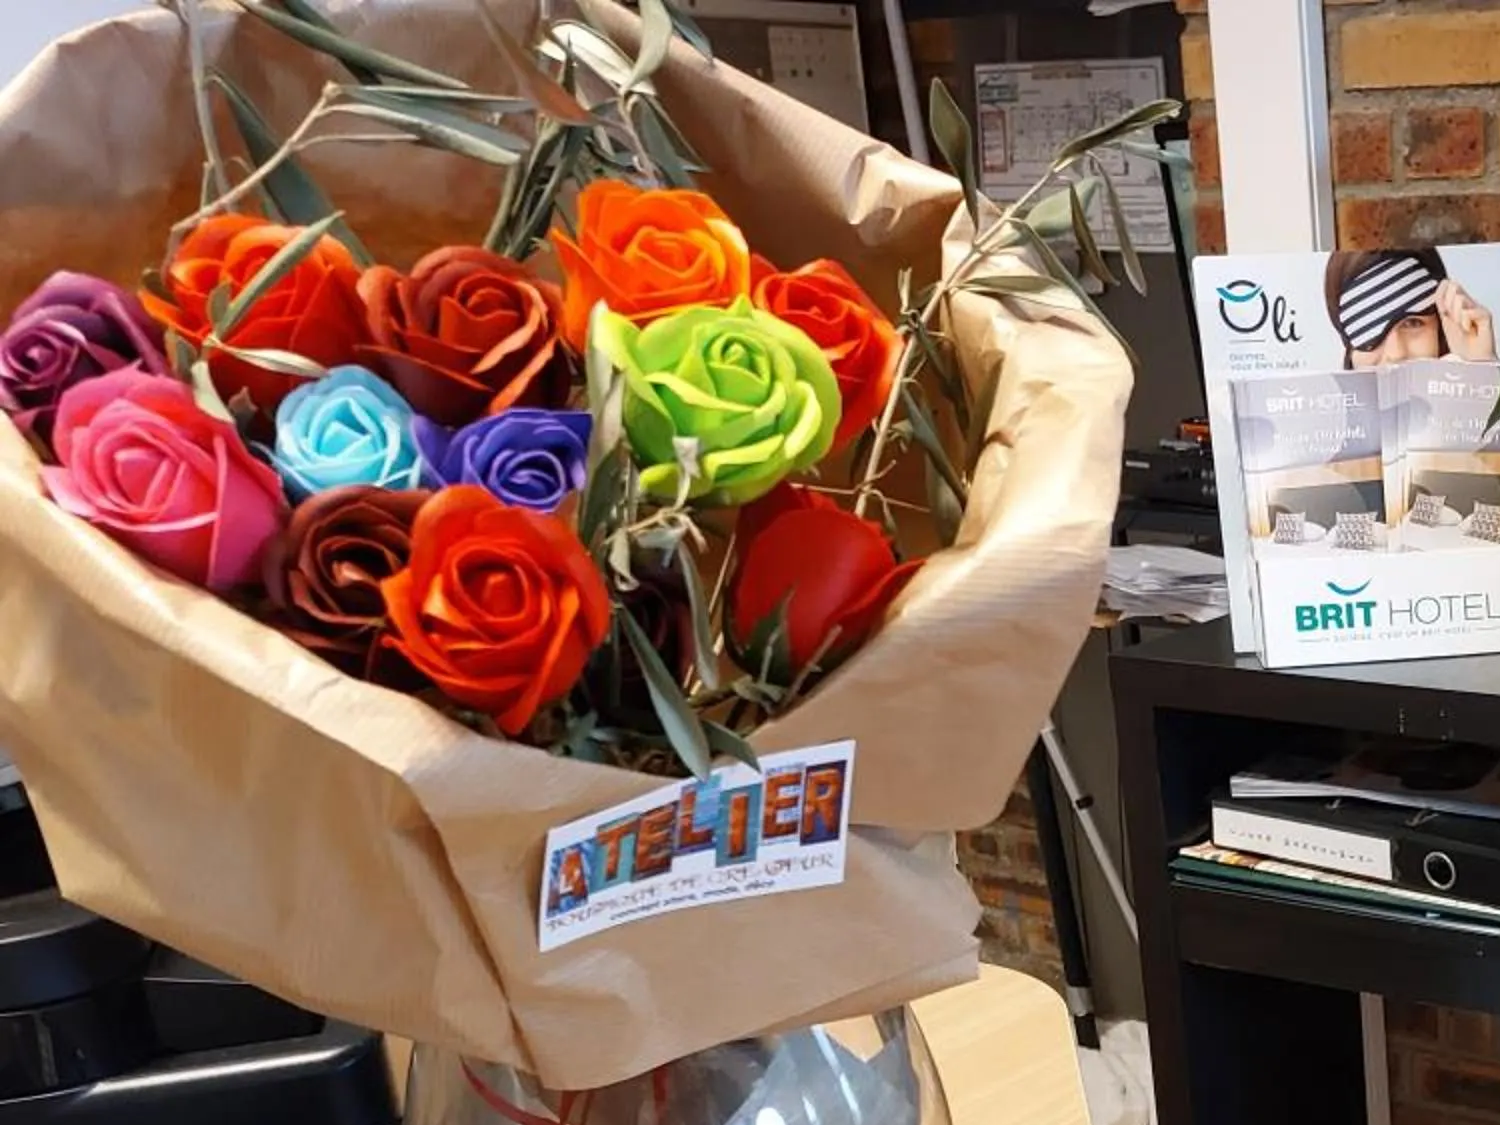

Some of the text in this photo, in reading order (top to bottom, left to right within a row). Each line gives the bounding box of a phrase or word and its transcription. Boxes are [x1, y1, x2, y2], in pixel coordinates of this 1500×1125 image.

[1216, 280, 1303, 343] Oli
[1265, 396, 1303, 413] BRIT
[1428, 380, 1500, 398] BRIT HOT
[1295, 600, 1377, 632] BRIT
[548, 765, 844, 910] ATELIER
